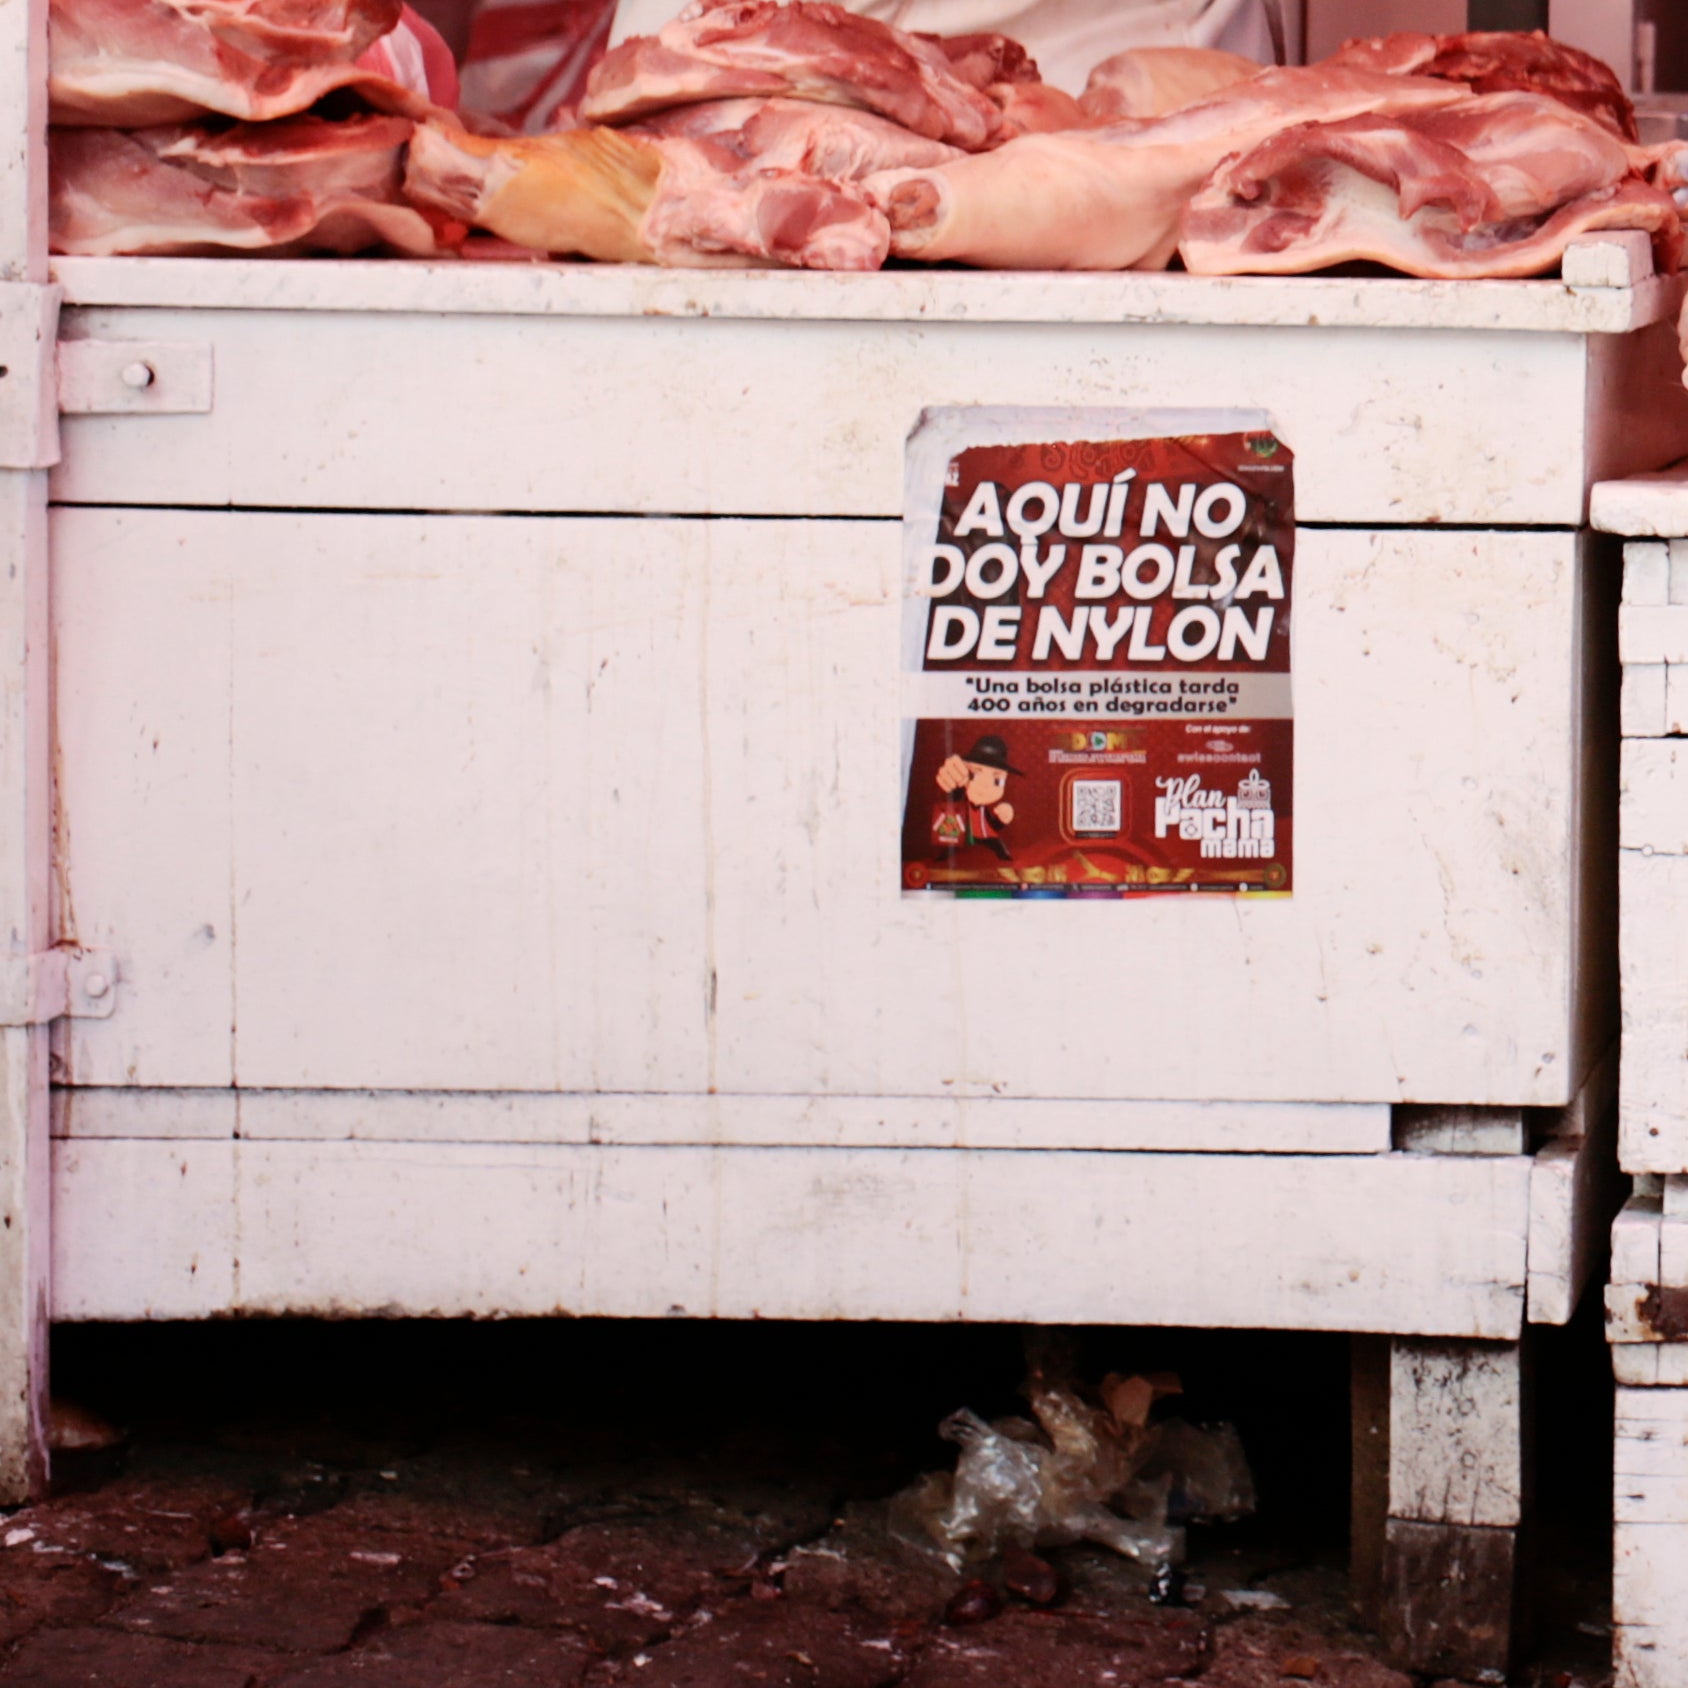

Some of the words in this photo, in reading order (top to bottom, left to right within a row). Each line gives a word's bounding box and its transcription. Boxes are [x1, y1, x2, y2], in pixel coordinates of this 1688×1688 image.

[953, 467, 1137, 546] AQUÍ
[1139, 482, 1247, 539] NO
[922, 543, 1066, 599] DOY
[1074, 543, 1285, 600] BOLSA
[926, 606, 1022, 660] DE
[1031, 605, 1275, 661] NYLON
[967, 698, 1010, 712] 400
[1018, 696, 1066, 712] años
[1073, 700, 1099, 712] en
[1026, 677, 1081, 693] bolsa
[1089, 676, 1172, 697] plástica
[1179, 677, 1239, 693] tarda
[1155, 773, 1227, 816] Plan
[1155, 796, 1274, 840] Pacha
[1200, 838, 1274, 859] mama
